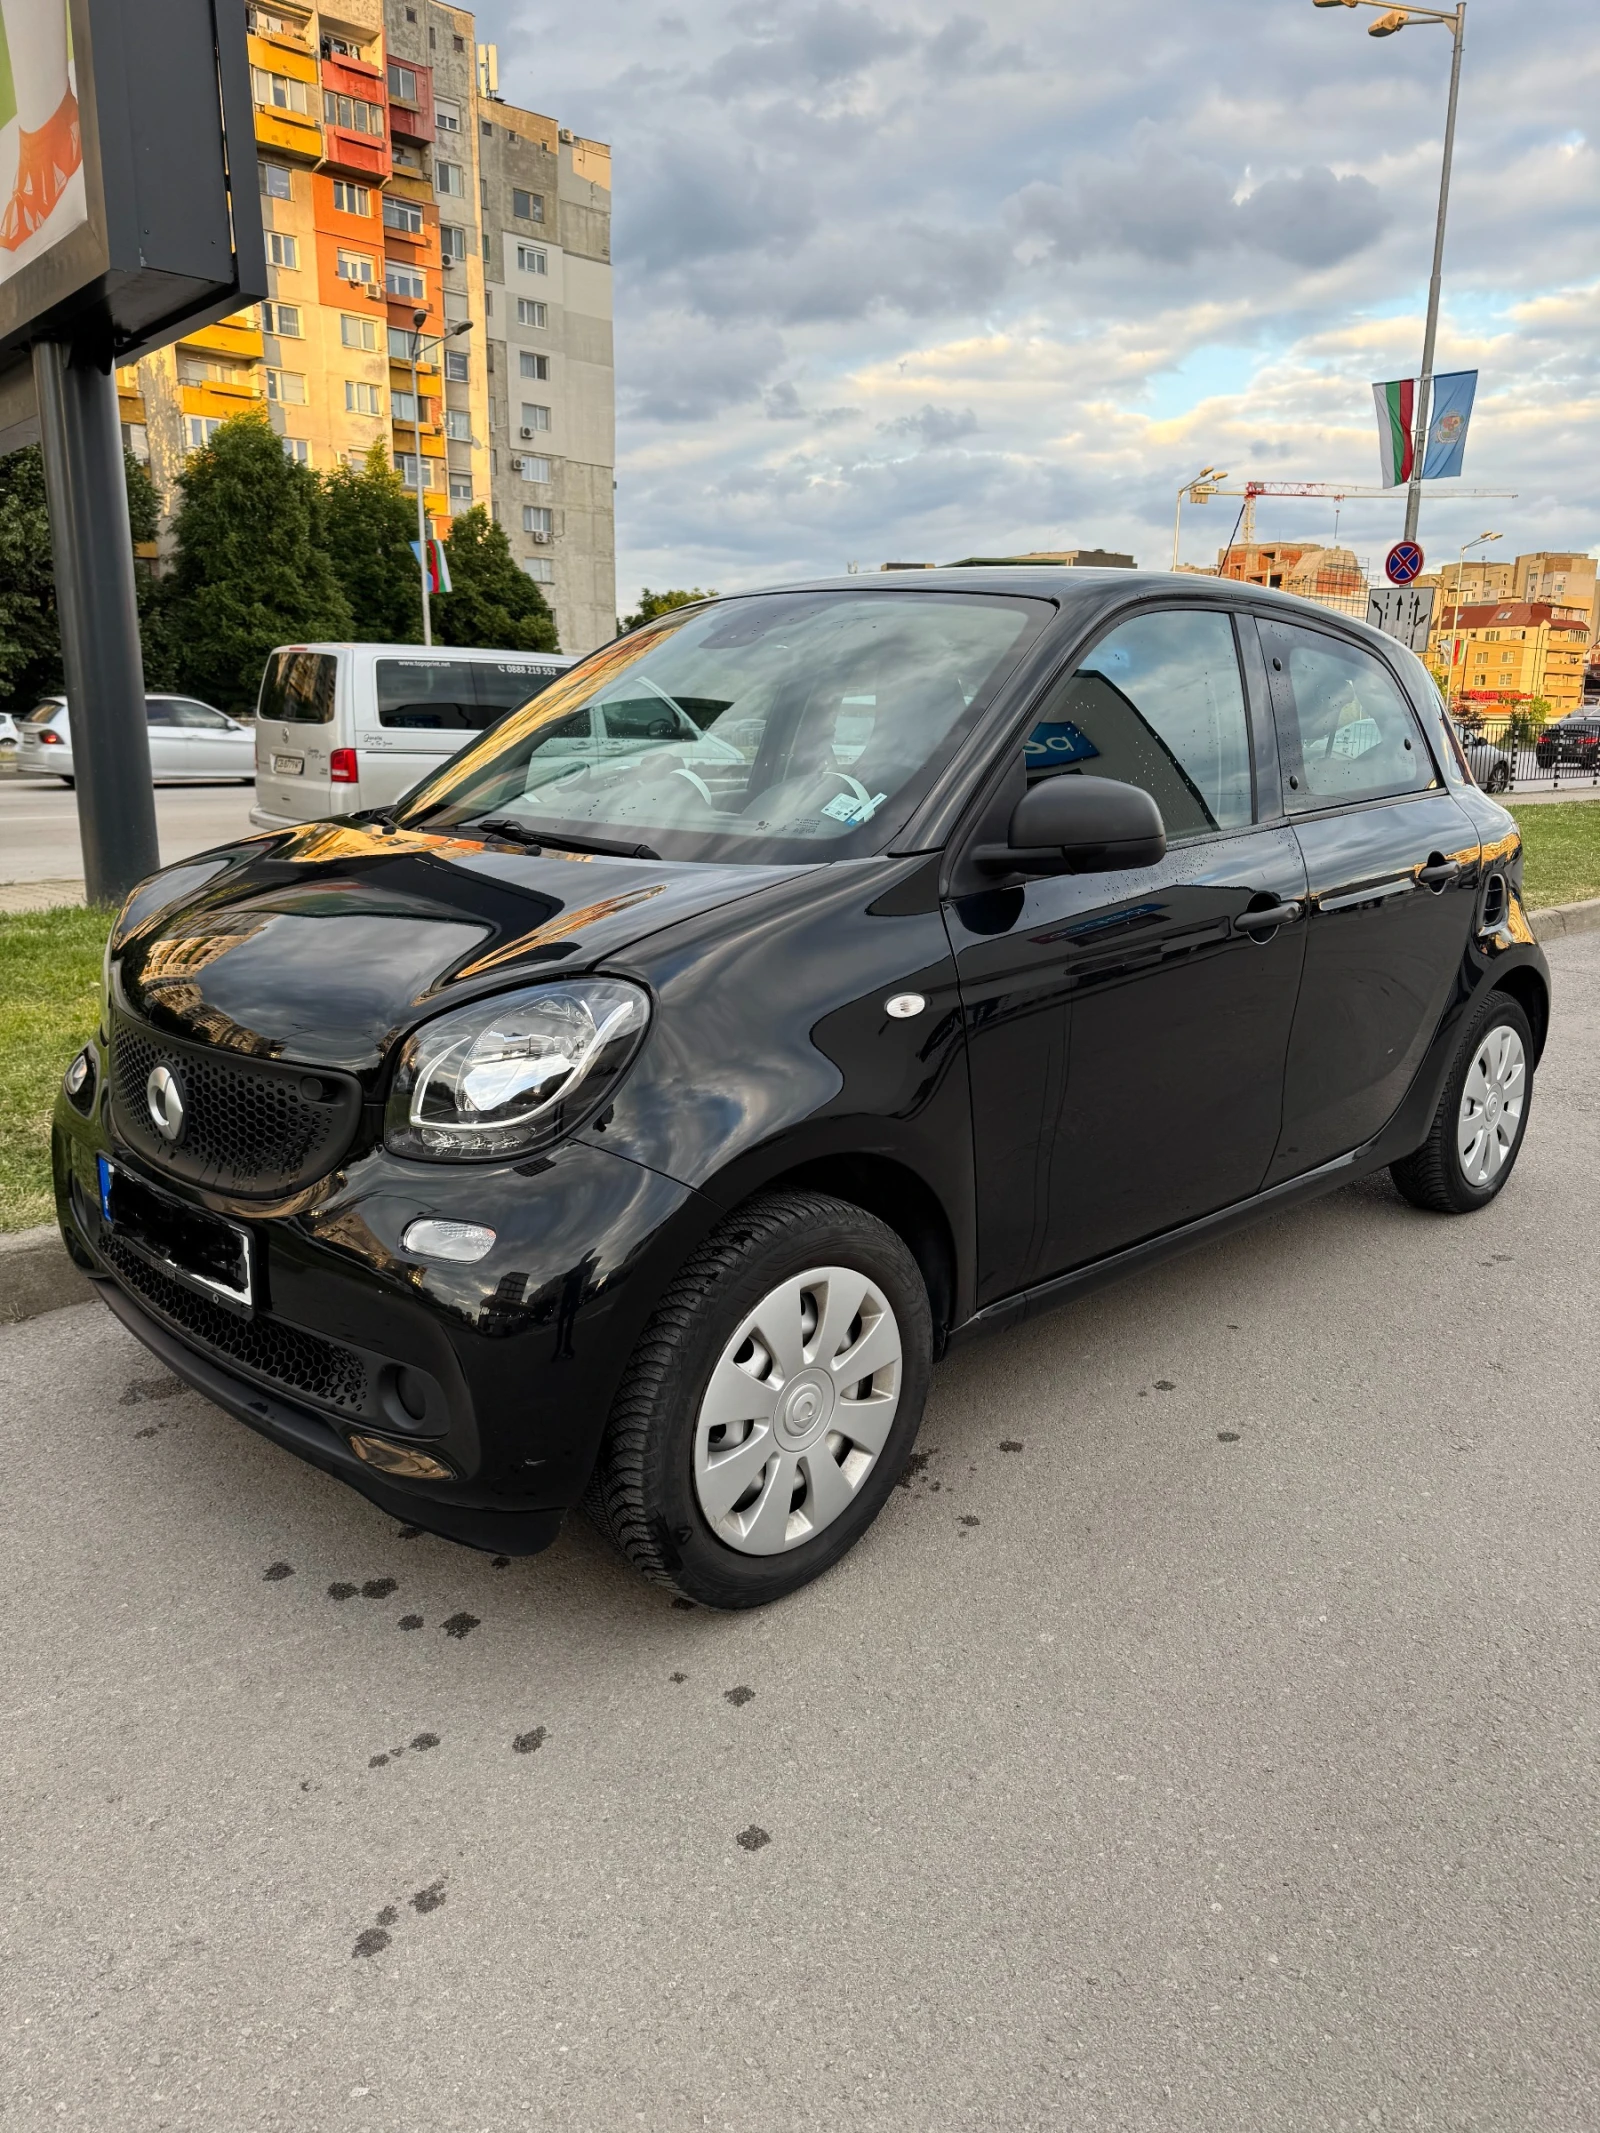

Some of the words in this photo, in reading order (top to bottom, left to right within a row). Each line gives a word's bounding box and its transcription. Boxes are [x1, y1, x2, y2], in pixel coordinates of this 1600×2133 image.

[506, 664, 526, 674] 0888
[527, 665, 541, 675] 219
[542, 667, 557, 676] 552
